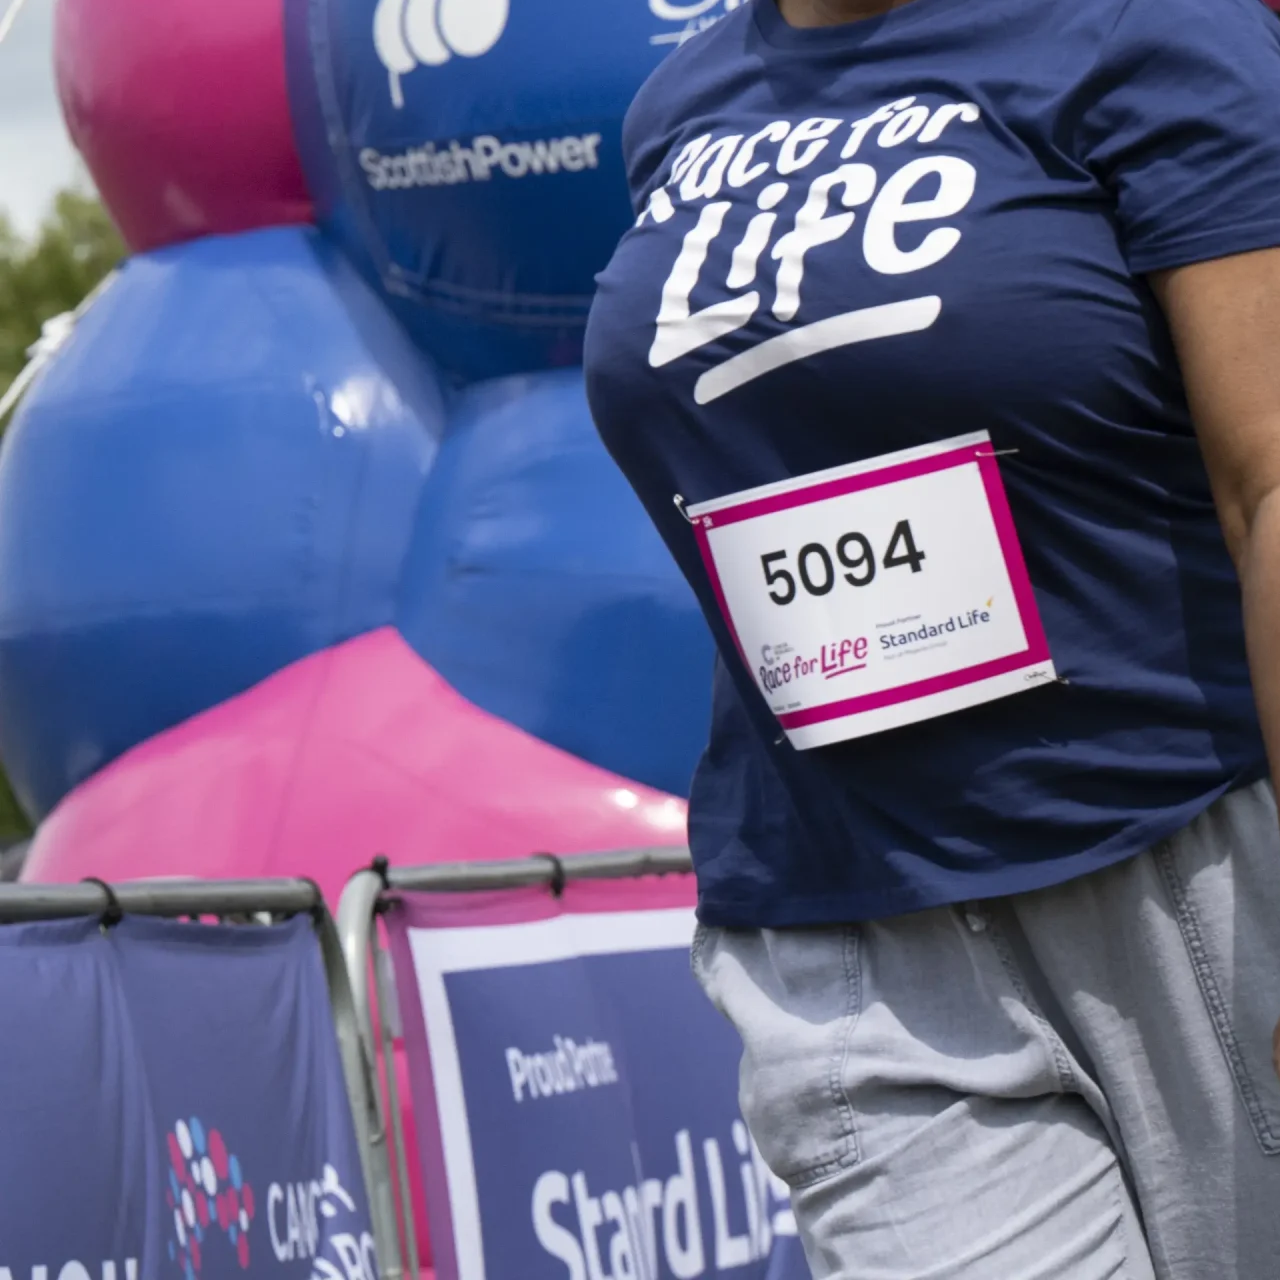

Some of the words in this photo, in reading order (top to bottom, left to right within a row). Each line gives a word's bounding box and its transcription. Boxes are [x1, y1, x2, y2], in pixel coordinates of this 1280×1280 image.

[840, 96, 980, 158] for
[358, 131, 601, 191] ScottishPower
[648, 155, 977, 368] Life
[760, 519, 926, 606] 5094
[879, 617, 957, 650] Standard
[956, 609, 991, 629] Life
[759, 662, 793, 695] Race
[793, 655, 819, 679] for
[820, 636, 869, 674] Life
